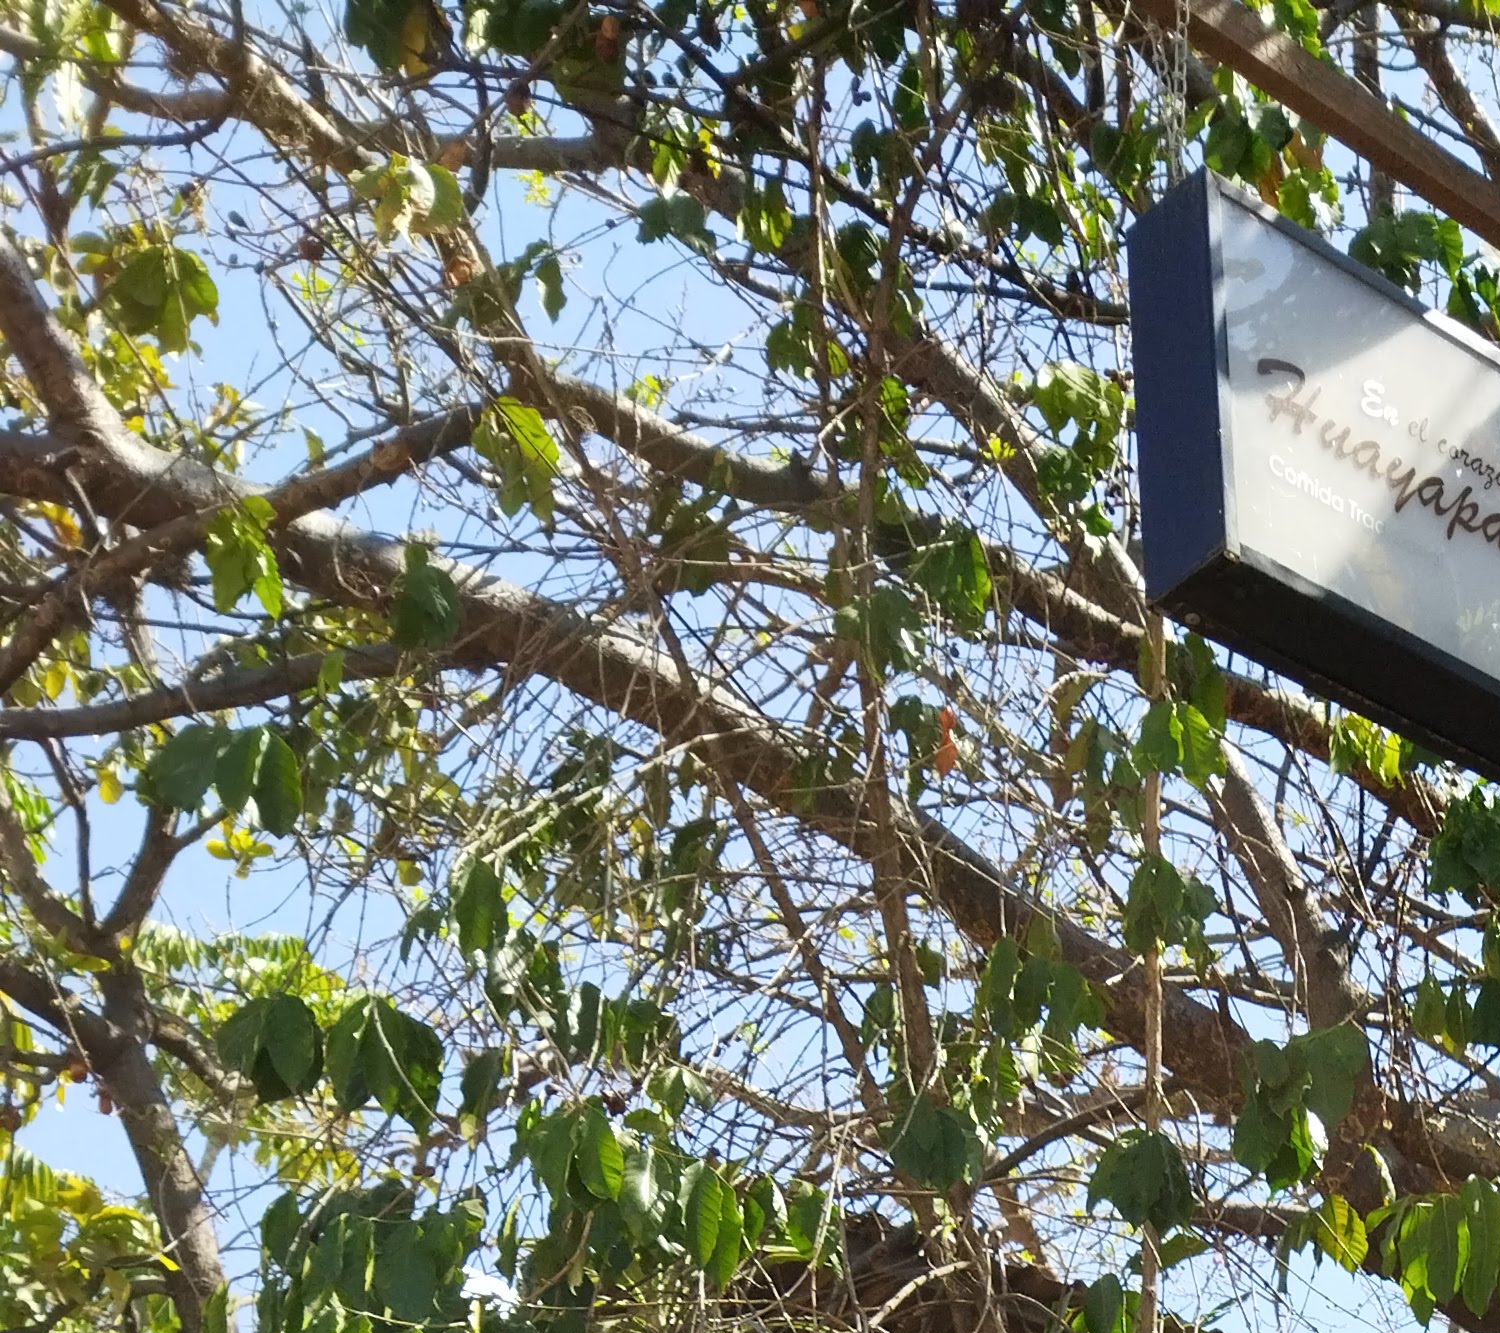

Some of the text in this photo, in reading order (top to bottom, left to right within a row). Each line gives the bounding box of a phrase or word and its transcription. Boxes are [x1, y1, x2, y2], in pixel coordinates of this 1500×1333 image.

[1360, 378, 1400, 427] En
[1408, 417, 1429, 442] el
[1269, 454, 1345, 514] Comida
